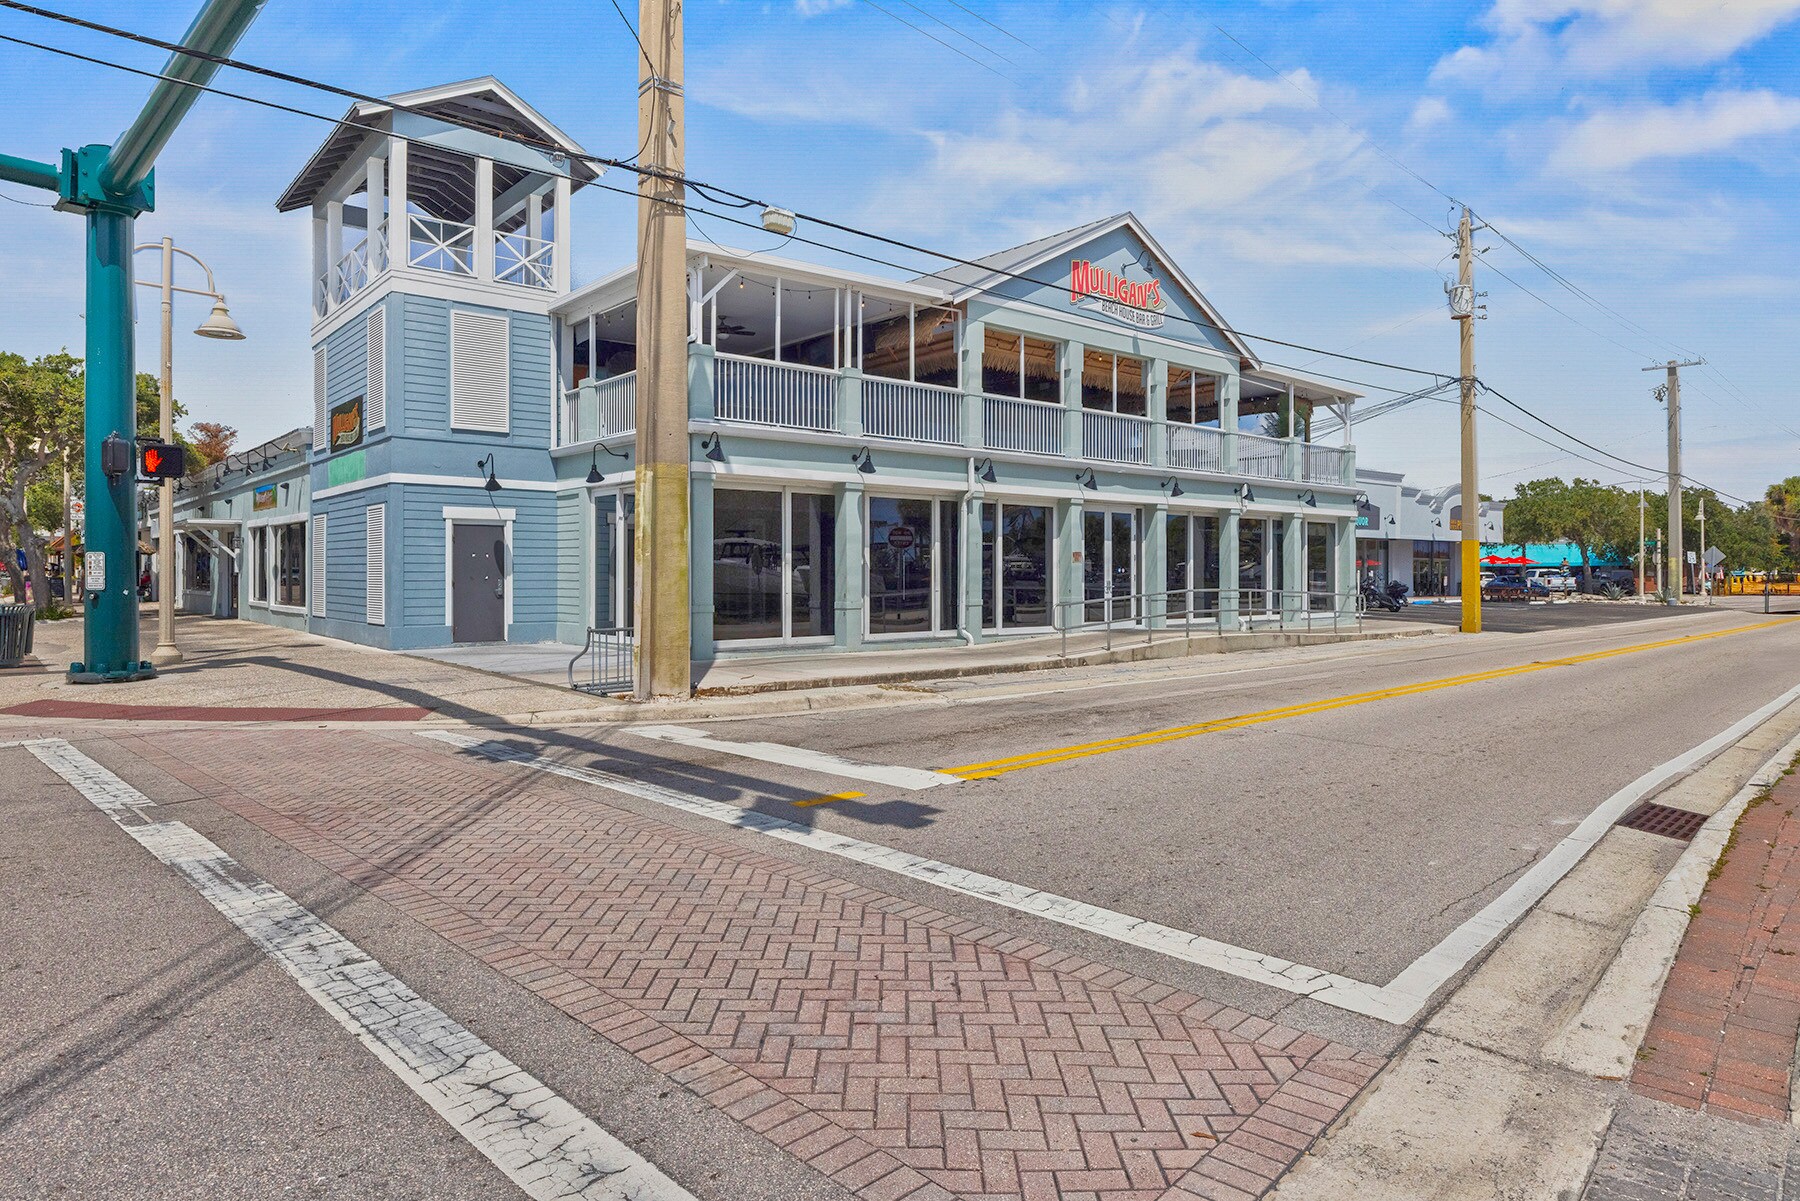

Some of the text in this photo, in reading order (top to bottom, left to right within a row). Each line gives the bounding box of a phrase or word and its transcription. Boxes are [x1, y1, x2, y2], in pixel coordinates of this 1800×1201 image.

[1071, 260, 1160, 308] MULLIGAN'S
[1101, 300, 1118, 315] BEACH
[1119, 306, 1135, 322] HOUSE
[1136, 312, 1146, 325] BAR
[1150, 314, 1163, 326] GRILL
